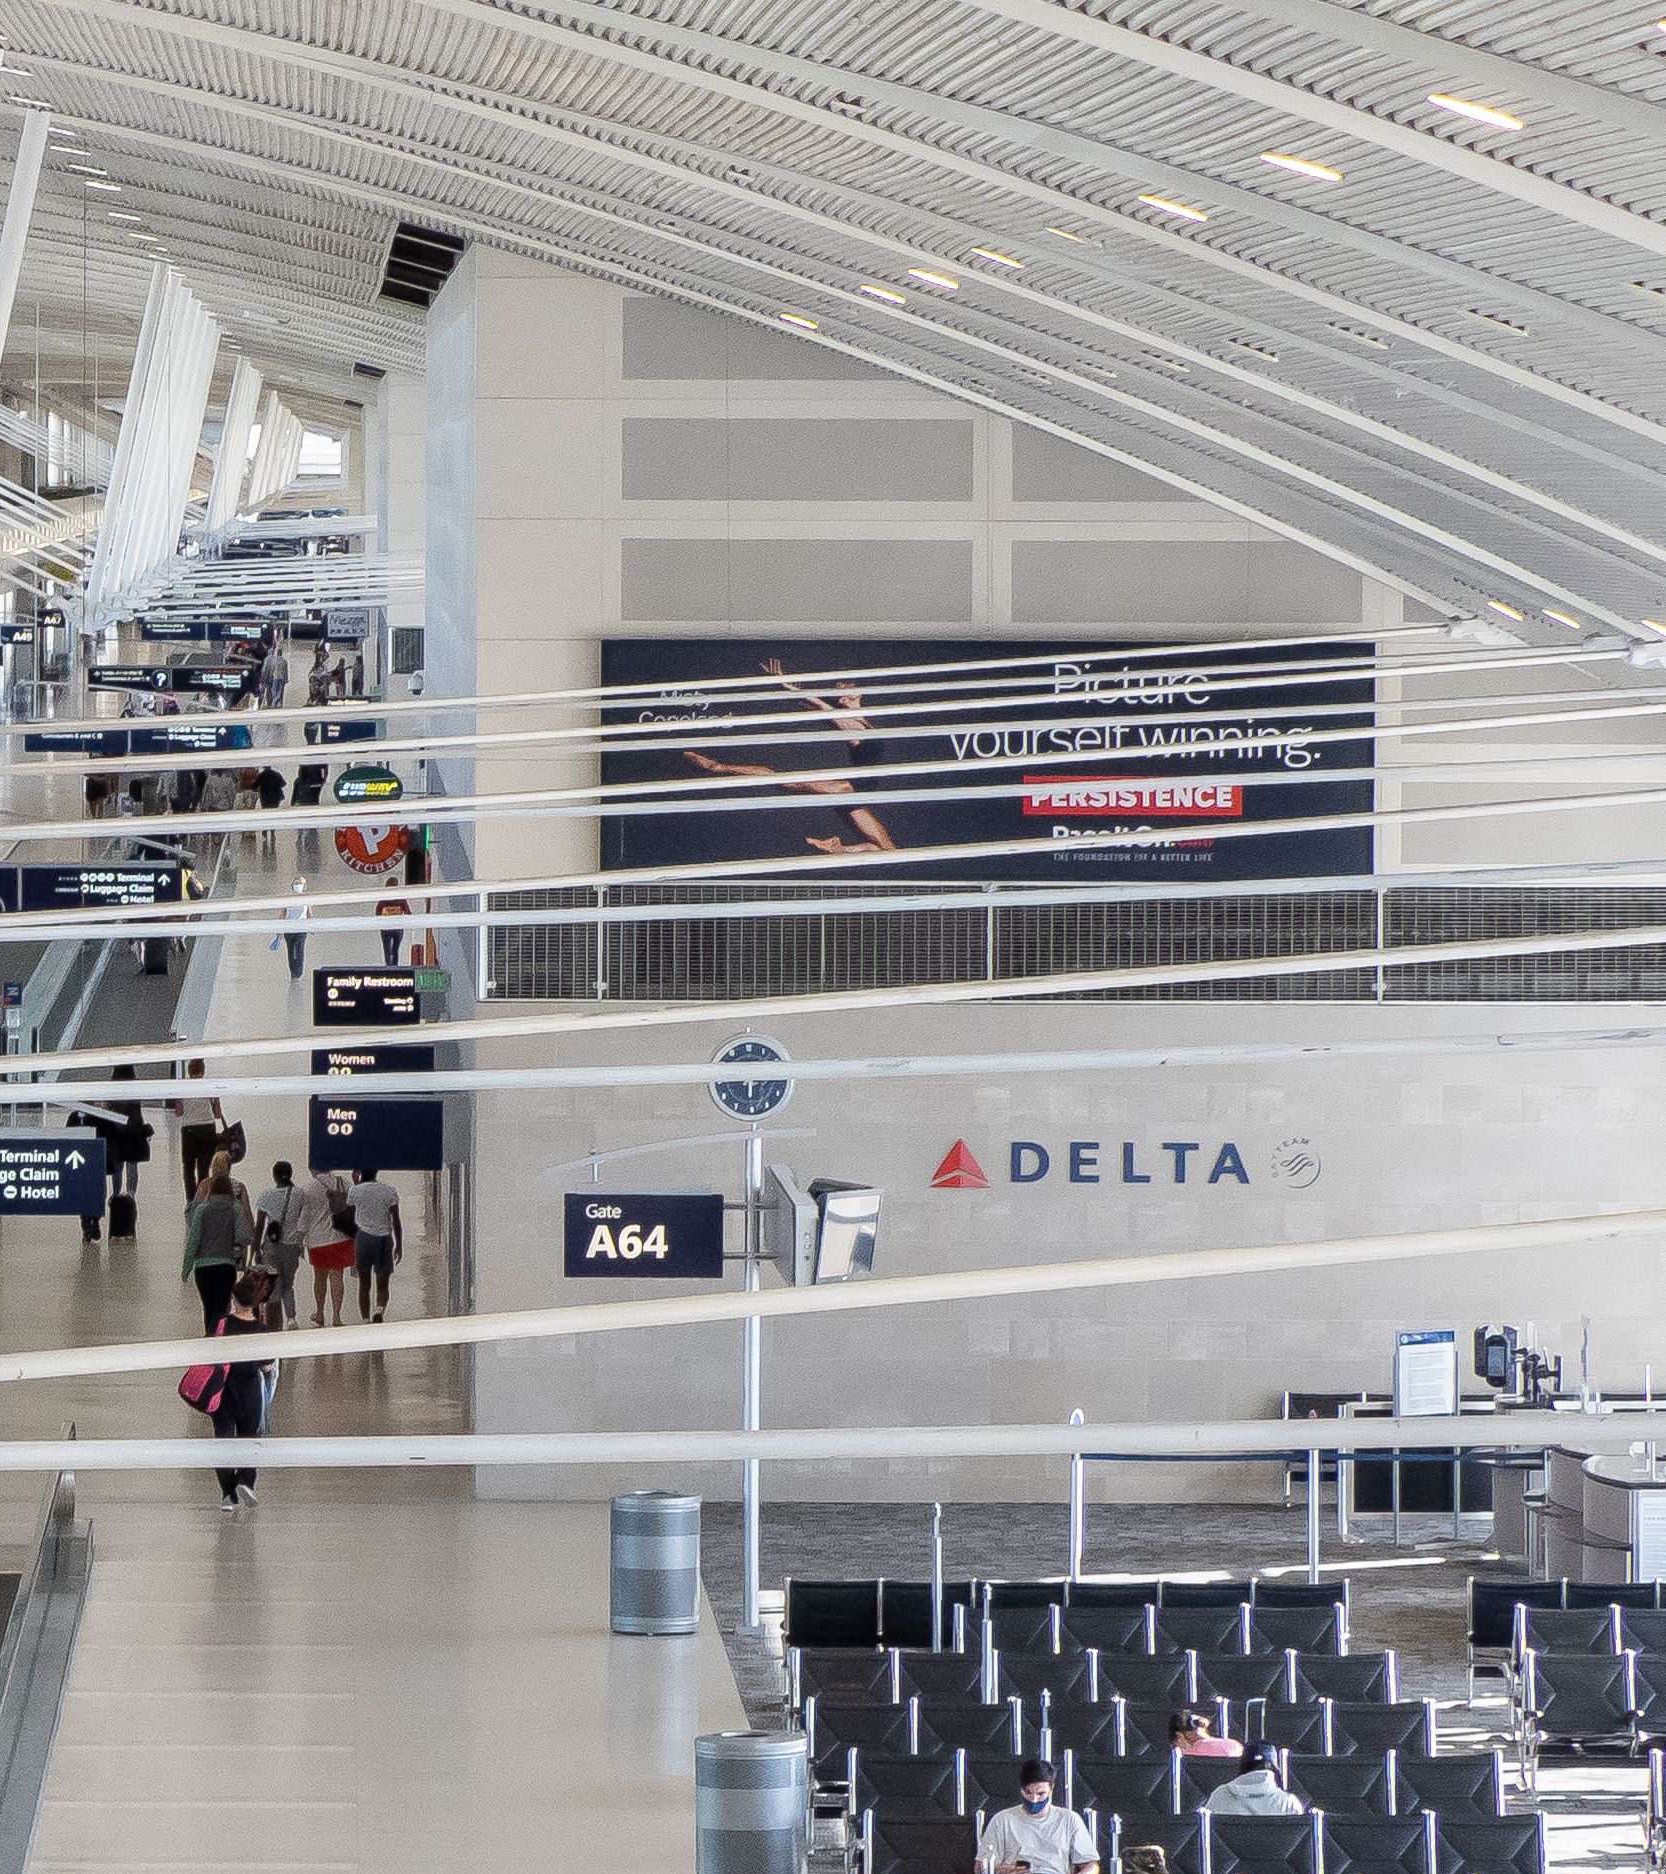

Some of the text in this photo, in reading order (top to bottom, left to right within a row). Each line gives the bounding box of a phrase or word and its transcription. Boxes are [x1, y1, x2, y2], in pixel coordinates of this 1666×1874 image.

[1054, 663, 1211, 704] Picture
[1030, 785, 1233, 809] PERSISTENCE
[117, 873, 155, 882] Terminal
[90, 884, 127, 895] Luggage
[327, 976, 362, 989] Family
[363, 977, 414, 988] Restroom
[328, 1053, 375, 1065] Women
[327, 1108, 357, 1120] Men
[0, 1149, 60, 1163] Terminal
[1010, 1141, 1251, 1185] DELTA
[20, 1167, 60, 1181] Claim
[20, 1185, 60, 1199] Hotel
[585, 1202, 622, 1219] Gate
[585, 1224, 669, 1259] A64
